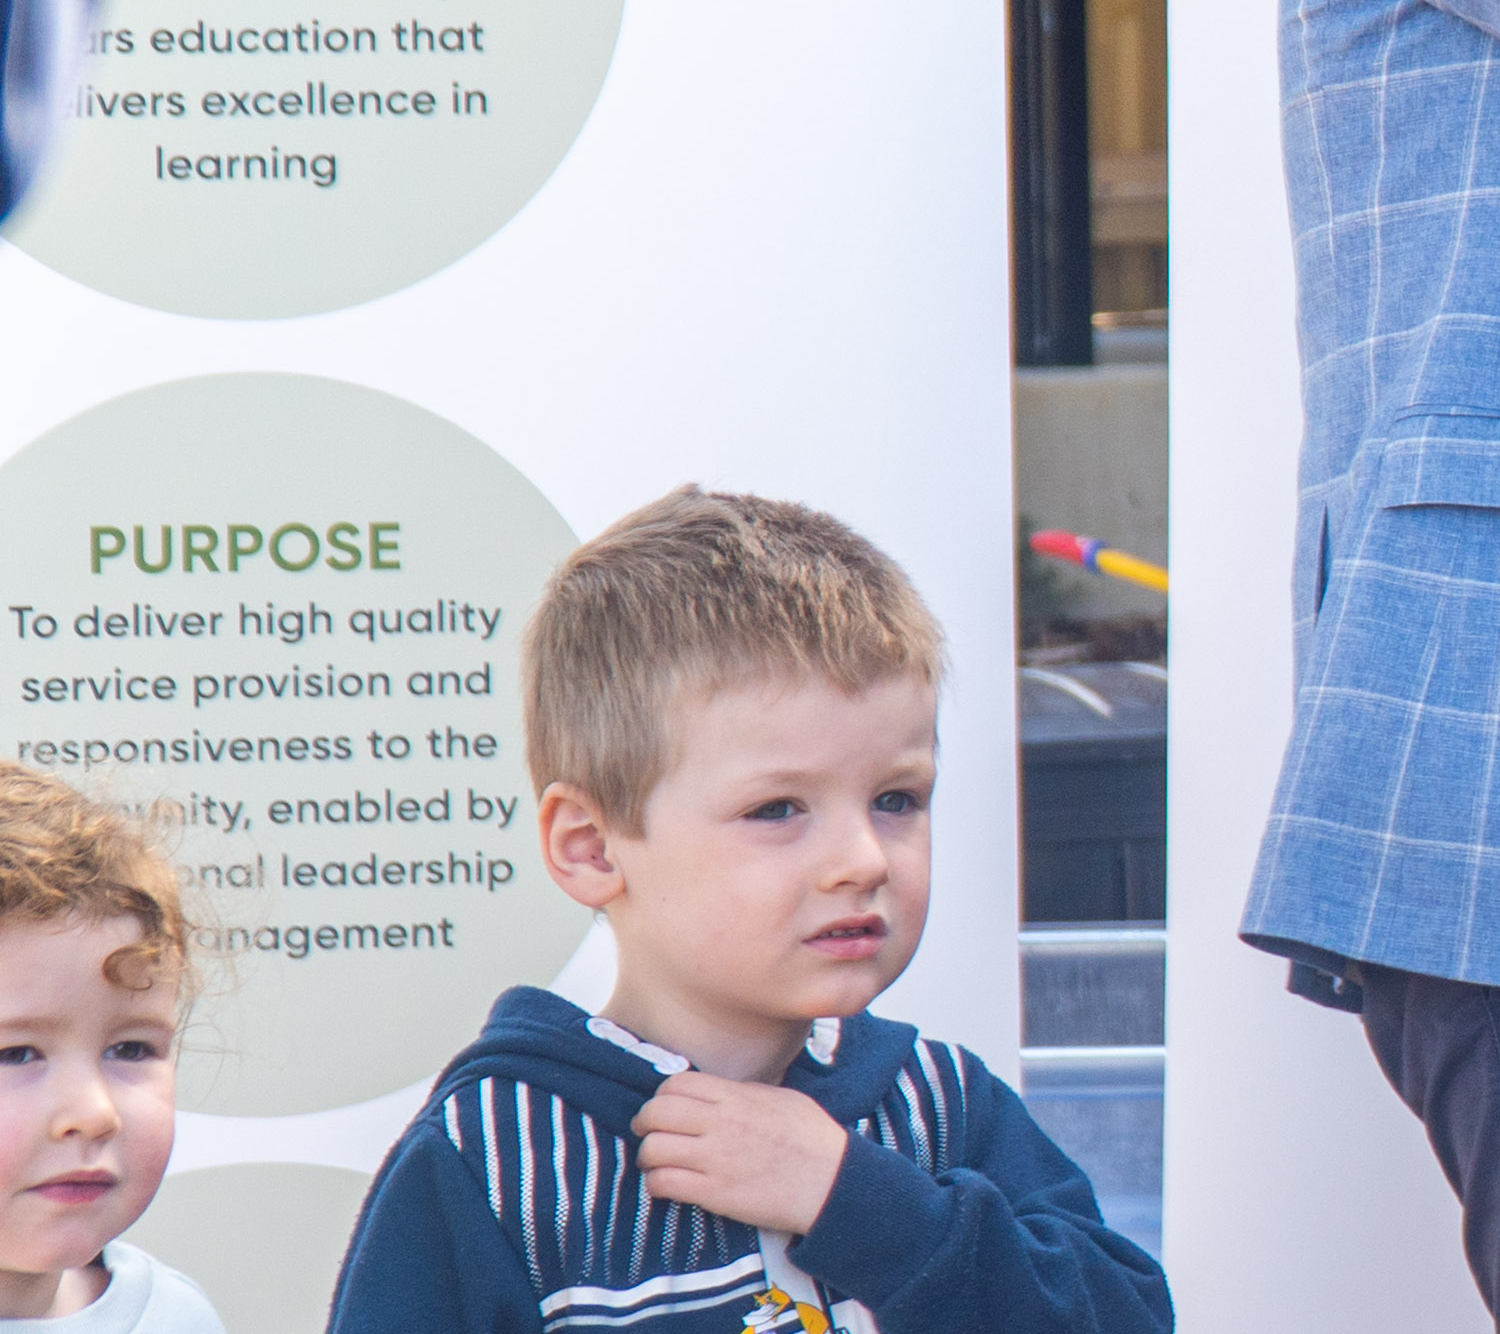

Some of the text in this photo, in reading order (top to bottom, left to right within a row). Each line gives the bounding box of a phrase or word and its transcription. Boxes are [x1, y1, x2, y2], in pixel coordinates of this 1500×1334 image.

[150, 19, 376, 54] education
[392, 19, 485, 53] that
[70, 81, 488, 119] livers excellence in
[155, 146, 338, 188] learning
[89, 521, 402, 574] PURPOSE
[9, 599, 502, 642] To deliver high quality
[21, 662, 492, 708] service provision and
[17, 725, 498, 772] responsiveness to the
[268, 789, 450, 826] enabled
[467, 788, 518, 828] by
[281, 850, 515, 891] leadership
[195, 917, 455, 960] anagement
